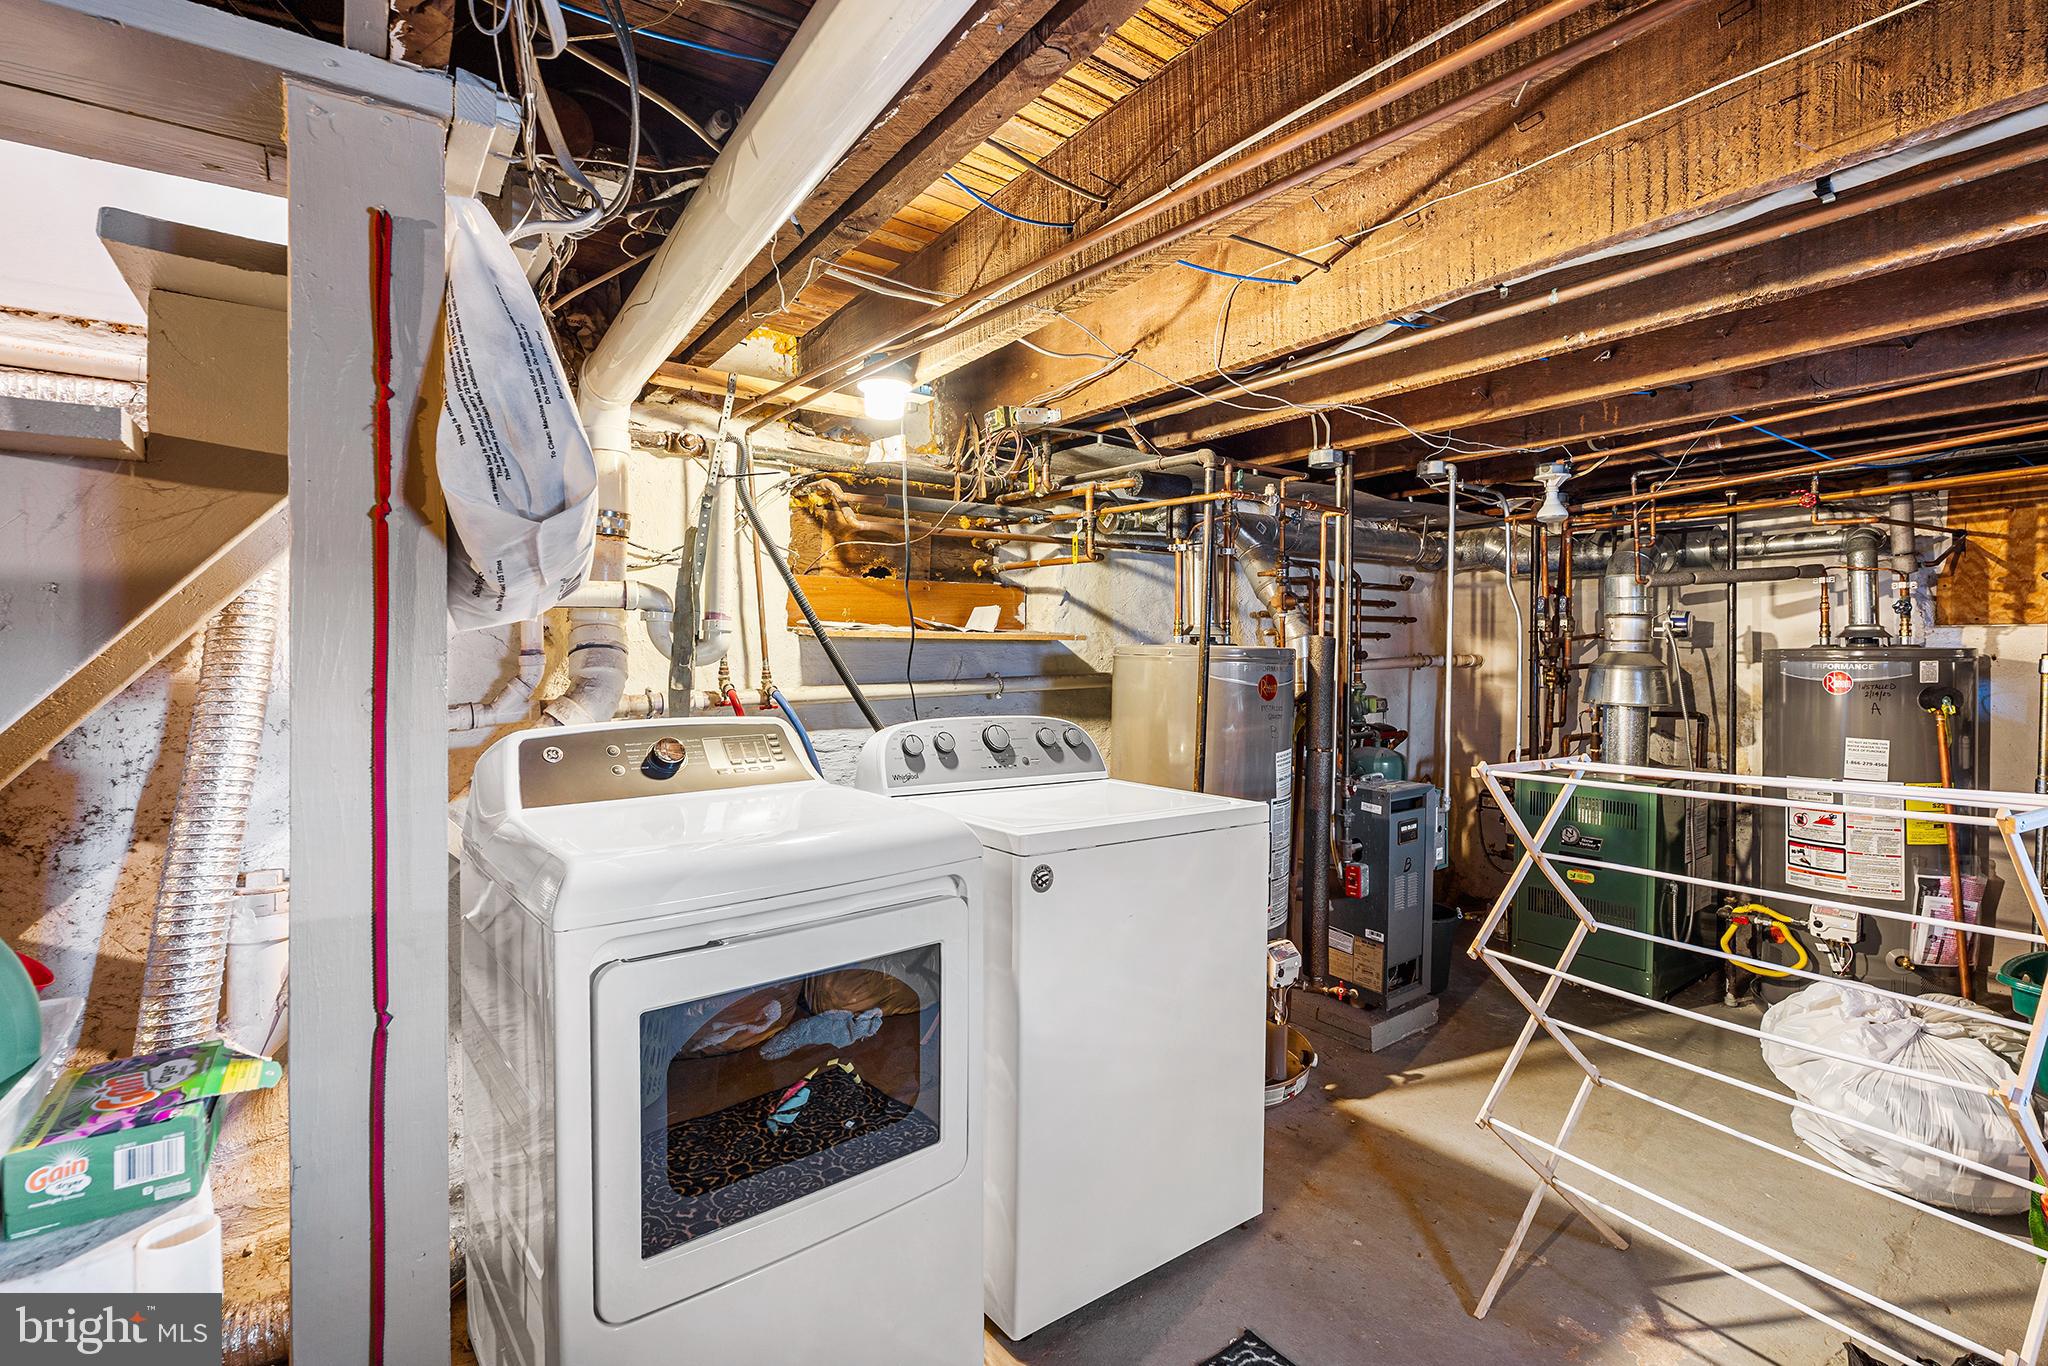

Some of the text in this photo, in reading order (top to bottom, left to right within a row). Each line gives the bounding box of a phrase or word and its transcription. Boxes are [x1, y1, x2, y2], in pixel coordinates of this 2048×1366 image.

[523, 352, 532, 367] clean
[528, 348, 536, 357] not
[455, 350, 464, 372] distance
[532, 357, 539, 365] Do
[466, 363, 478, 389] cadmium
[529, 374, 538, 387] cold
[473, 389, 484, 405] lead,
[533, 387, 541, 403] wash
[544, 395, 551, 404] Do
[444, 400, 454, 416] made
[458, 392, 475, 424] non-woven
[467, 395, 478, 411] carry
[538, 404, 548, 429] Machine
[454, 423, 462, 434] bag
[488, 429, 496, 440] not
[475, 431, 485, 447] made
[545, 430, 554, 449] Clean:
[493, 441, 501, 456] does
[550, 450, 556, 458] To
[484, 454, 492, 465] bag
[495, 464, 503, 477] This
[487, 466, 497, 492] reusable
[1871, 702, 1882, 716] A
[892, 772, 919, 783] Whirlpool
[1403, 857, 1412, 872] B
[29, 1158, 87, 1191] Gain
